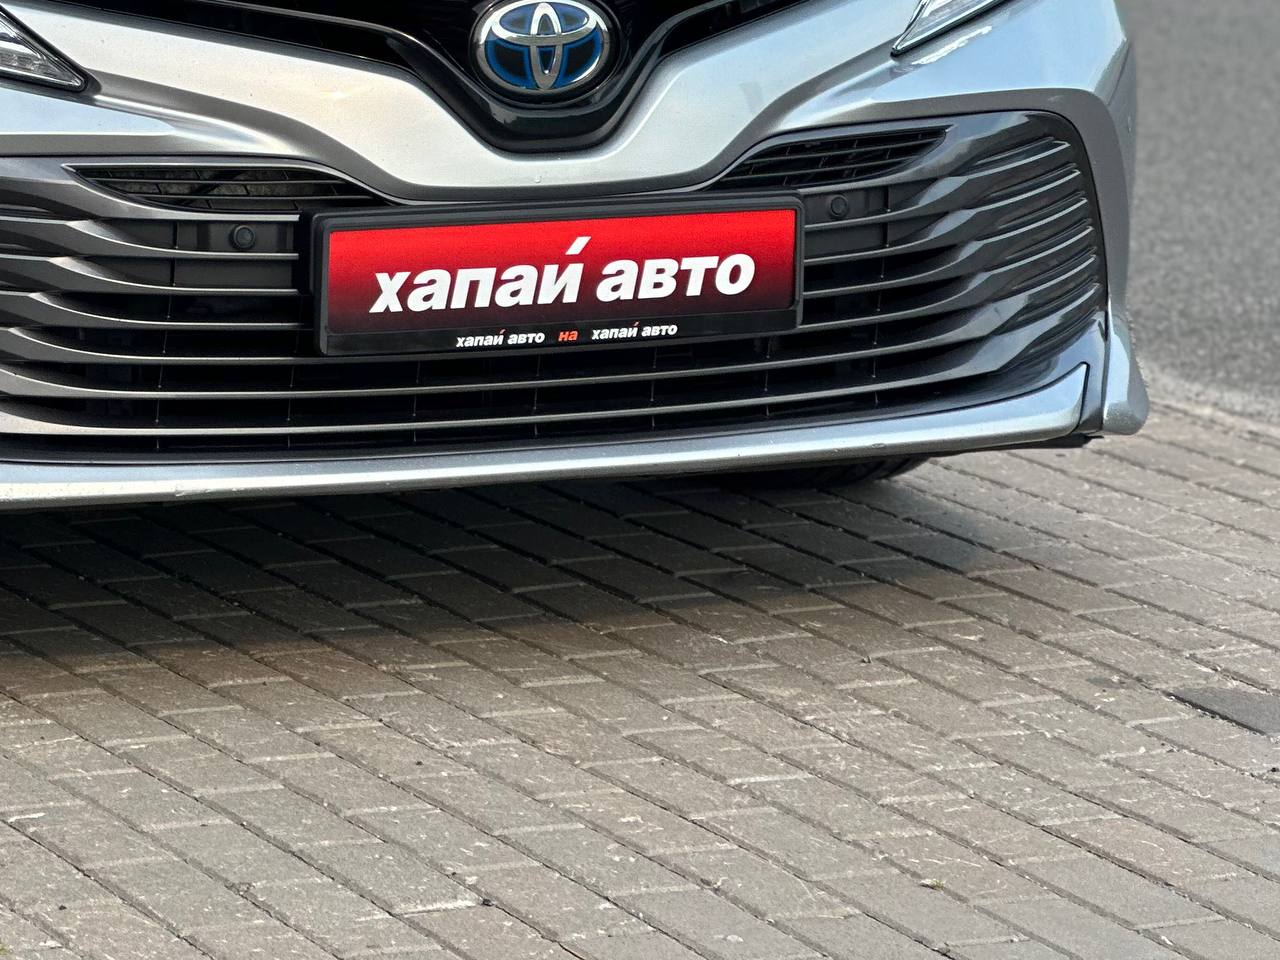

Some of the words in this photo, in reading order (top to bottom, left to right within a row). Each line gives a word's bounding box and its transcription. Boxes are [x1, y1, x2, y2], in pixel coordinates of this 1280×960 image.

[595, 253, 756, 303] авто
[507, 332, 546, 345] авто
[557, 330, 579, 342] на
[640, 324, 678, 337] авто
